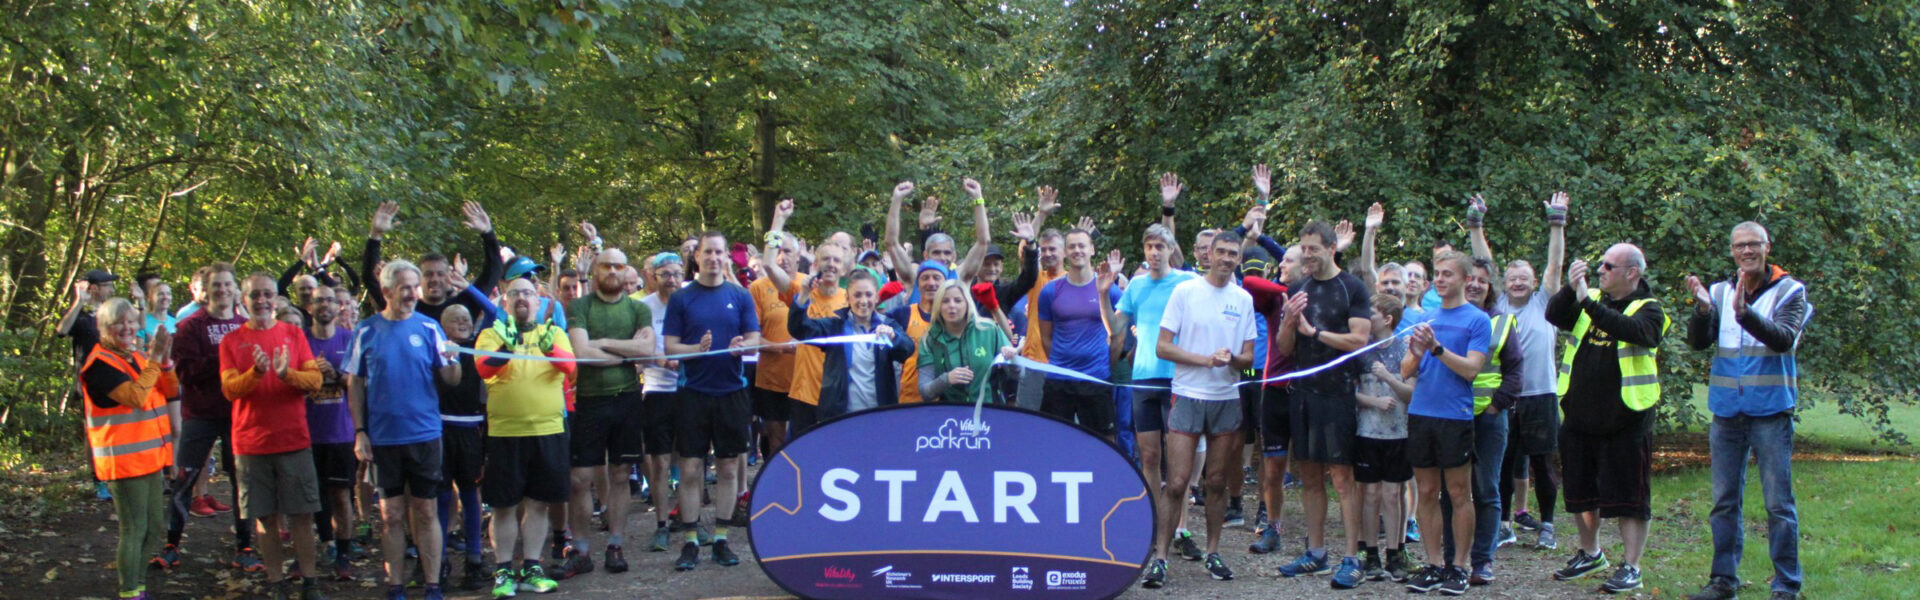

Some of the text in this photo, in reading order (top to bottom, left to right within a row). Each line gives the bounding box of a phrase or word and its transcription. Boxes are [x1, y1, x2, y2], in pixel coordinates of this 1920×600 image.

[915, 427, 991, 452] parkrun
[818, 467, 1093, 523] START
[823, 565, 856, 583] Vitality
[940, 574, 996, 583] INTERSPORT
[1062, 571, 1087, 579] exodus
[1062, 577, 1087, 585] travels
[1012, 583, 1032, 591] Society
